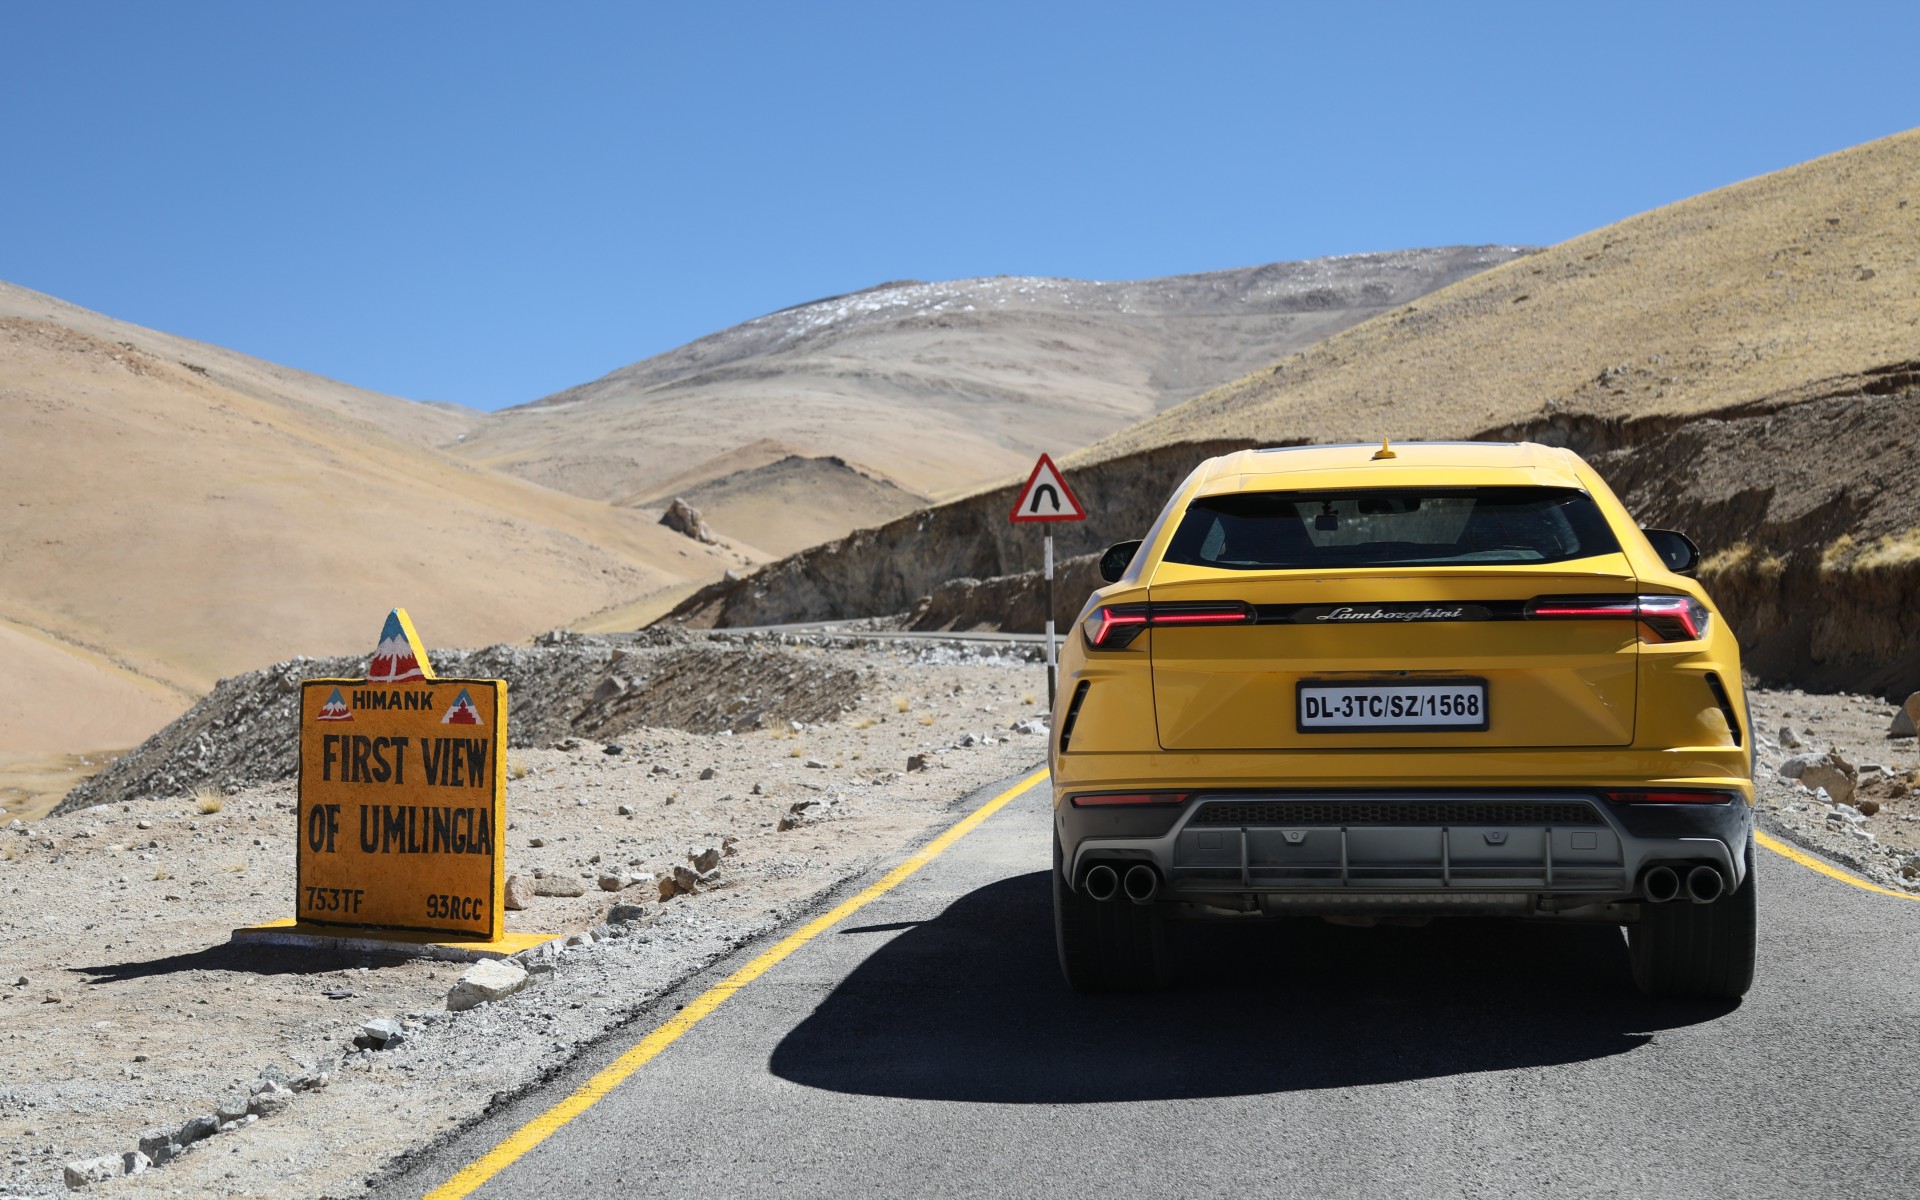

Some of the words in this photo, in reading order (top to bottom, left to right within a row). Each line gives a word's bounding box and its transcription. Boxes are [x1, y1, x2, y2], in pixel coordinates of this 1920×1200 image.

[1316, 607, 1463, 621] Lamborghini
[352, 690, 434, 711] HIMANK
[1305, 694, 1480, 719] DL-3TC/SZ/1568
[322, 734, 409, 785] FIRST
[421, 738, 488, 788] VIEW
[308, 804, 341, 854] OF
[360, 805, 492, 855] UMLINGLA
